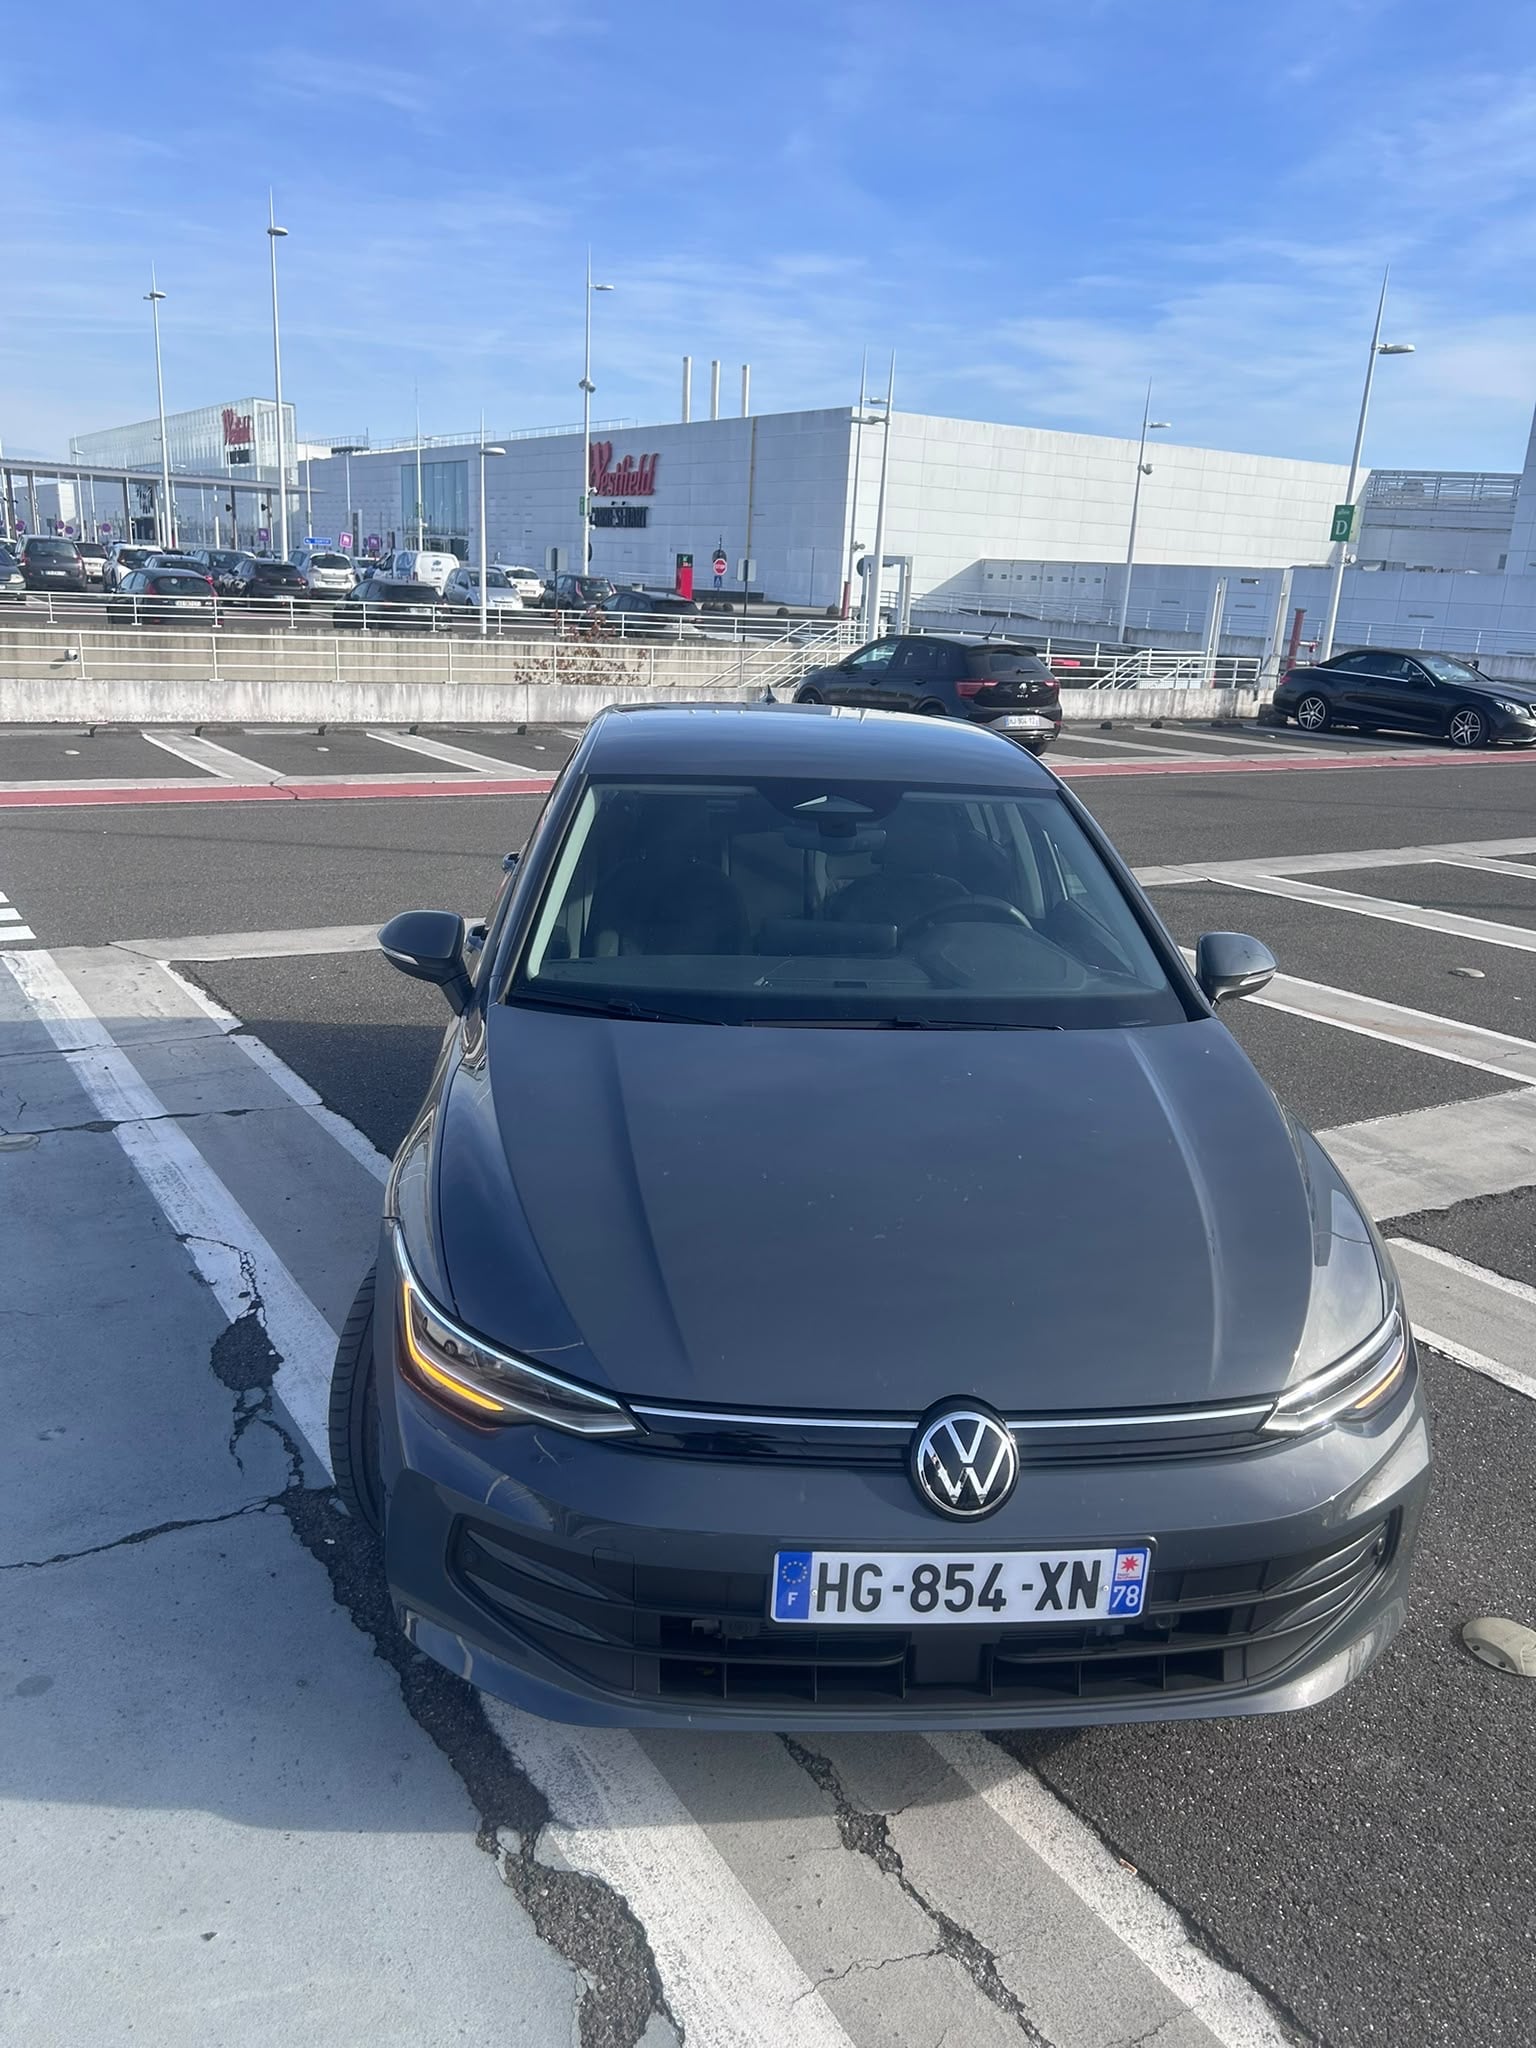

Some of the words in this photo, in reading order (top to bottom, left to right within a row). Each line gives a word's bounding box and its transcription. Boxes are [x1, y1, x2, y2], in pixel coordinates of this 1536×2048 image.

[590, 441, 659, 496] Westfield
[1335, 520, 1348, 535] D
[816, 1559, 1102, 1613] HG-854-XN
[1111, 1585, 1140, 1608] 78
[787, 1592, 799, 1606] F
